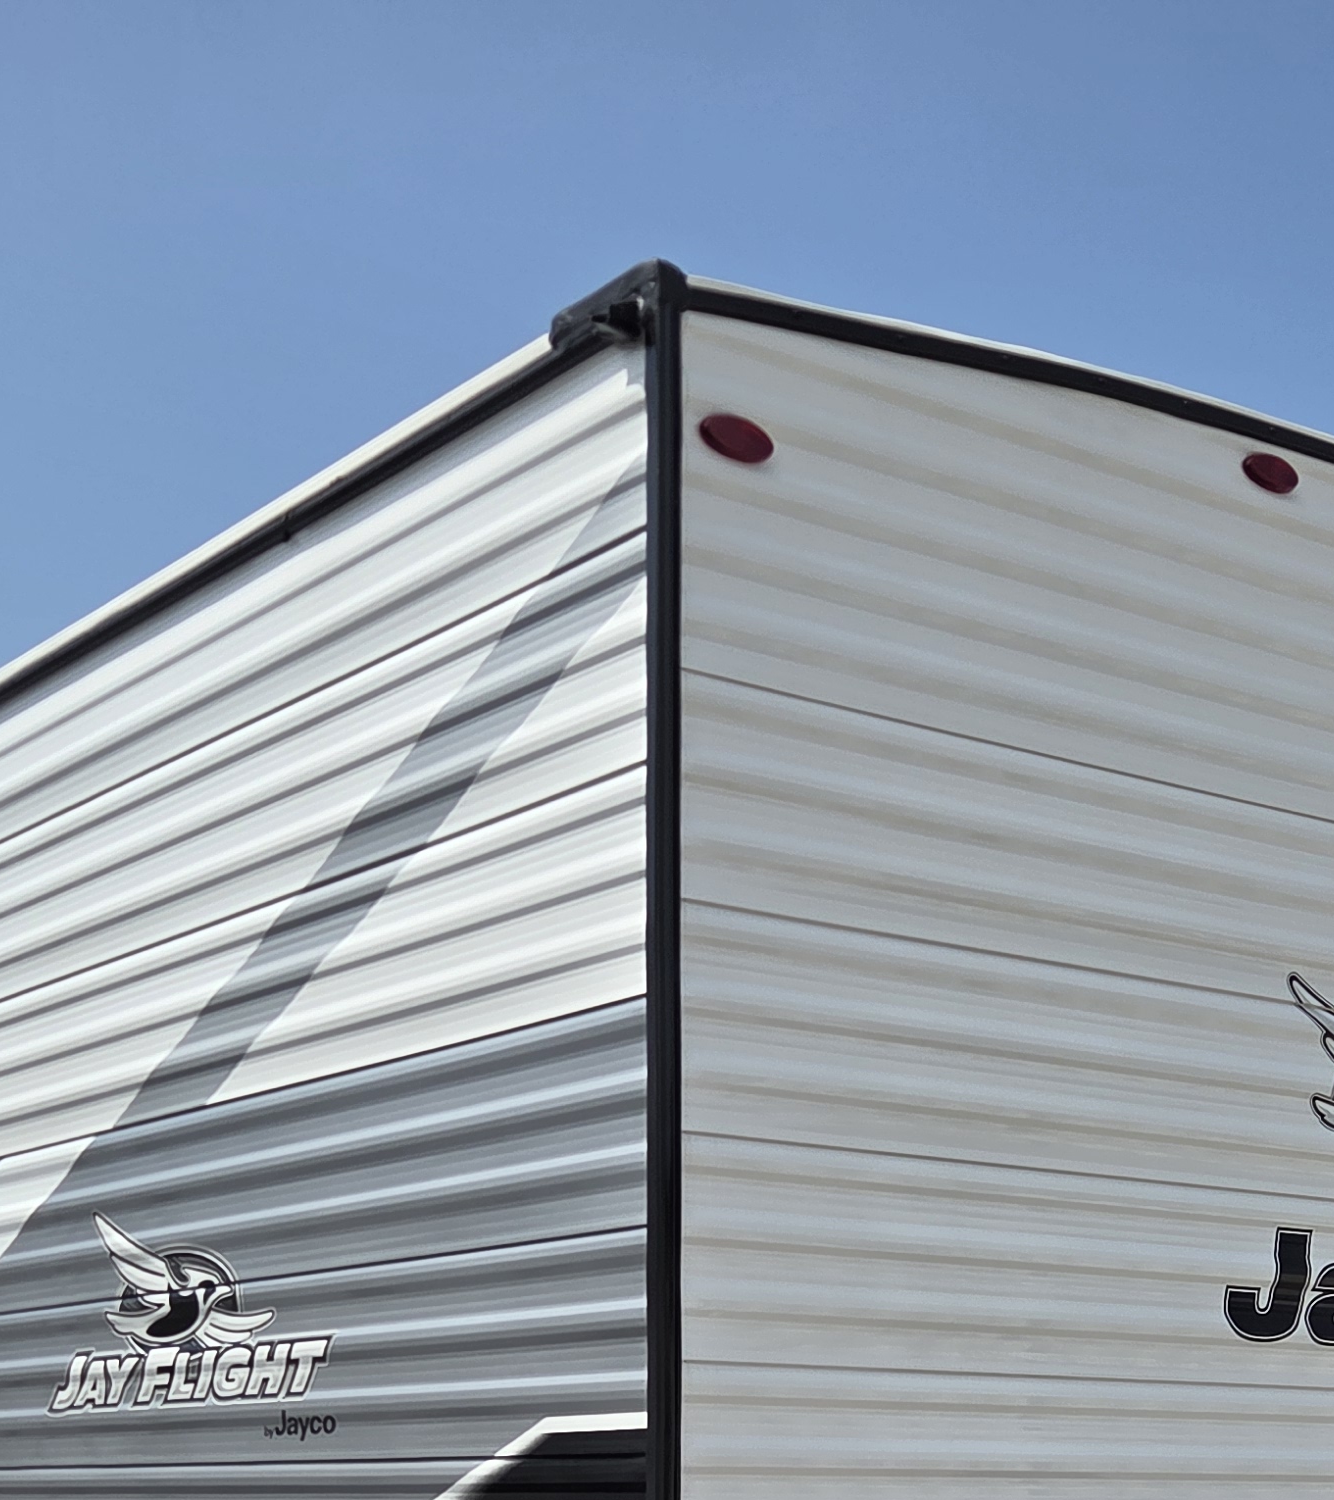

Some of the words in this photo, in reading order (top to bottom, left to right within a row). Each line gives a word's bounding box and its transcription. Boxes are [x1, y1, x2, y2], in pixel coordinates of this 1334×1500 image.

[48, 1349, 140, 1414] JAY
[132, 1334, 332, 1406] FLIGHT
[274, 1410, 337, 1441] Jayco
